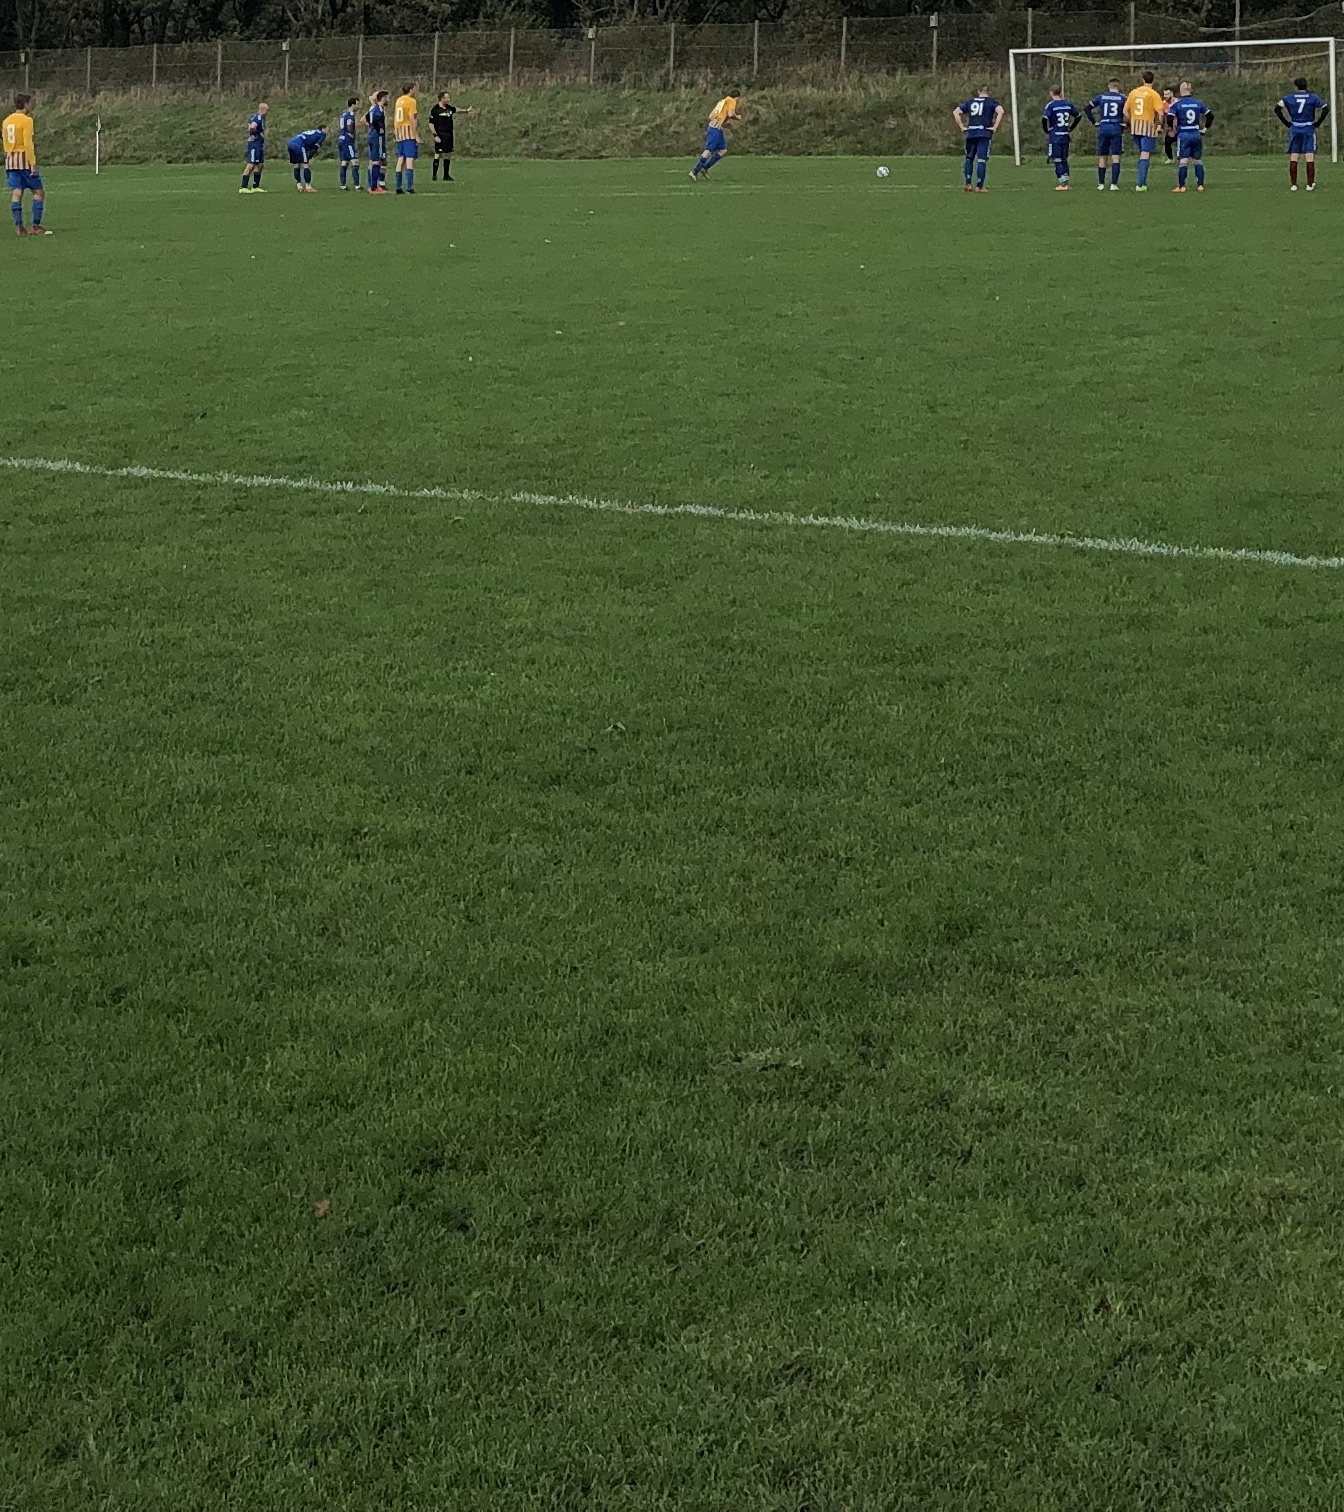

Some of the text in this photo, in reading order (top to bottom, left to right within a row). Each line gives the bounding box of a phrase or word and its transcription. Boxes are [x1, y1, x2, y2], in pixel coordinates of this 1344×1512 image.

[970, 102, 984, 116] 91
[1103, 102, 1118, 117] 13
[1134, 98, 1144, 115] 3
[1296, 99, 1306, 114] 7
[1186, 109, 1196, 124] 9
[7, 124, 15, 143] 8
